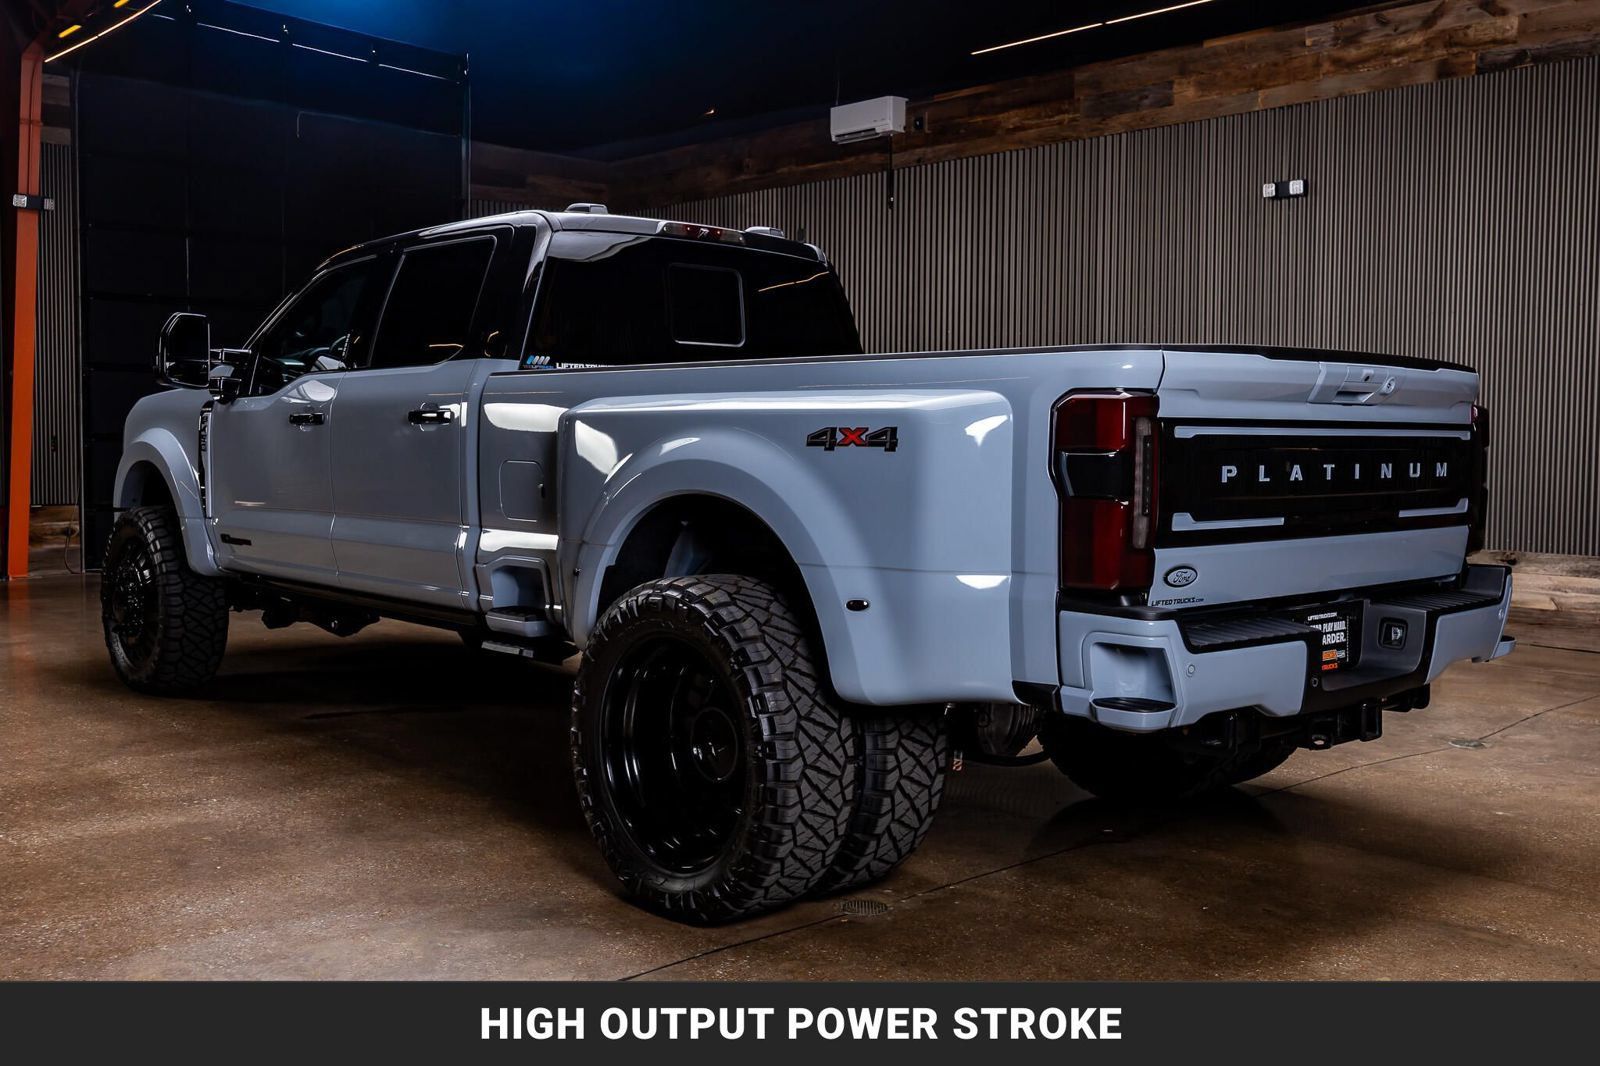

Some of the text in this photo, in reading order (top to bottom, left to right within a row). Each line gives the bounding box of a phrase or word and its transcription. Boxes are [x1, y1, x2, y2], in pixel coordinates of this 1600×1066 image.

[806, 426, 898, 452] 4X4
[1221, 462, 1448, 483] PLATINUM
[1322, 632, 1346, 646] ARDER.
